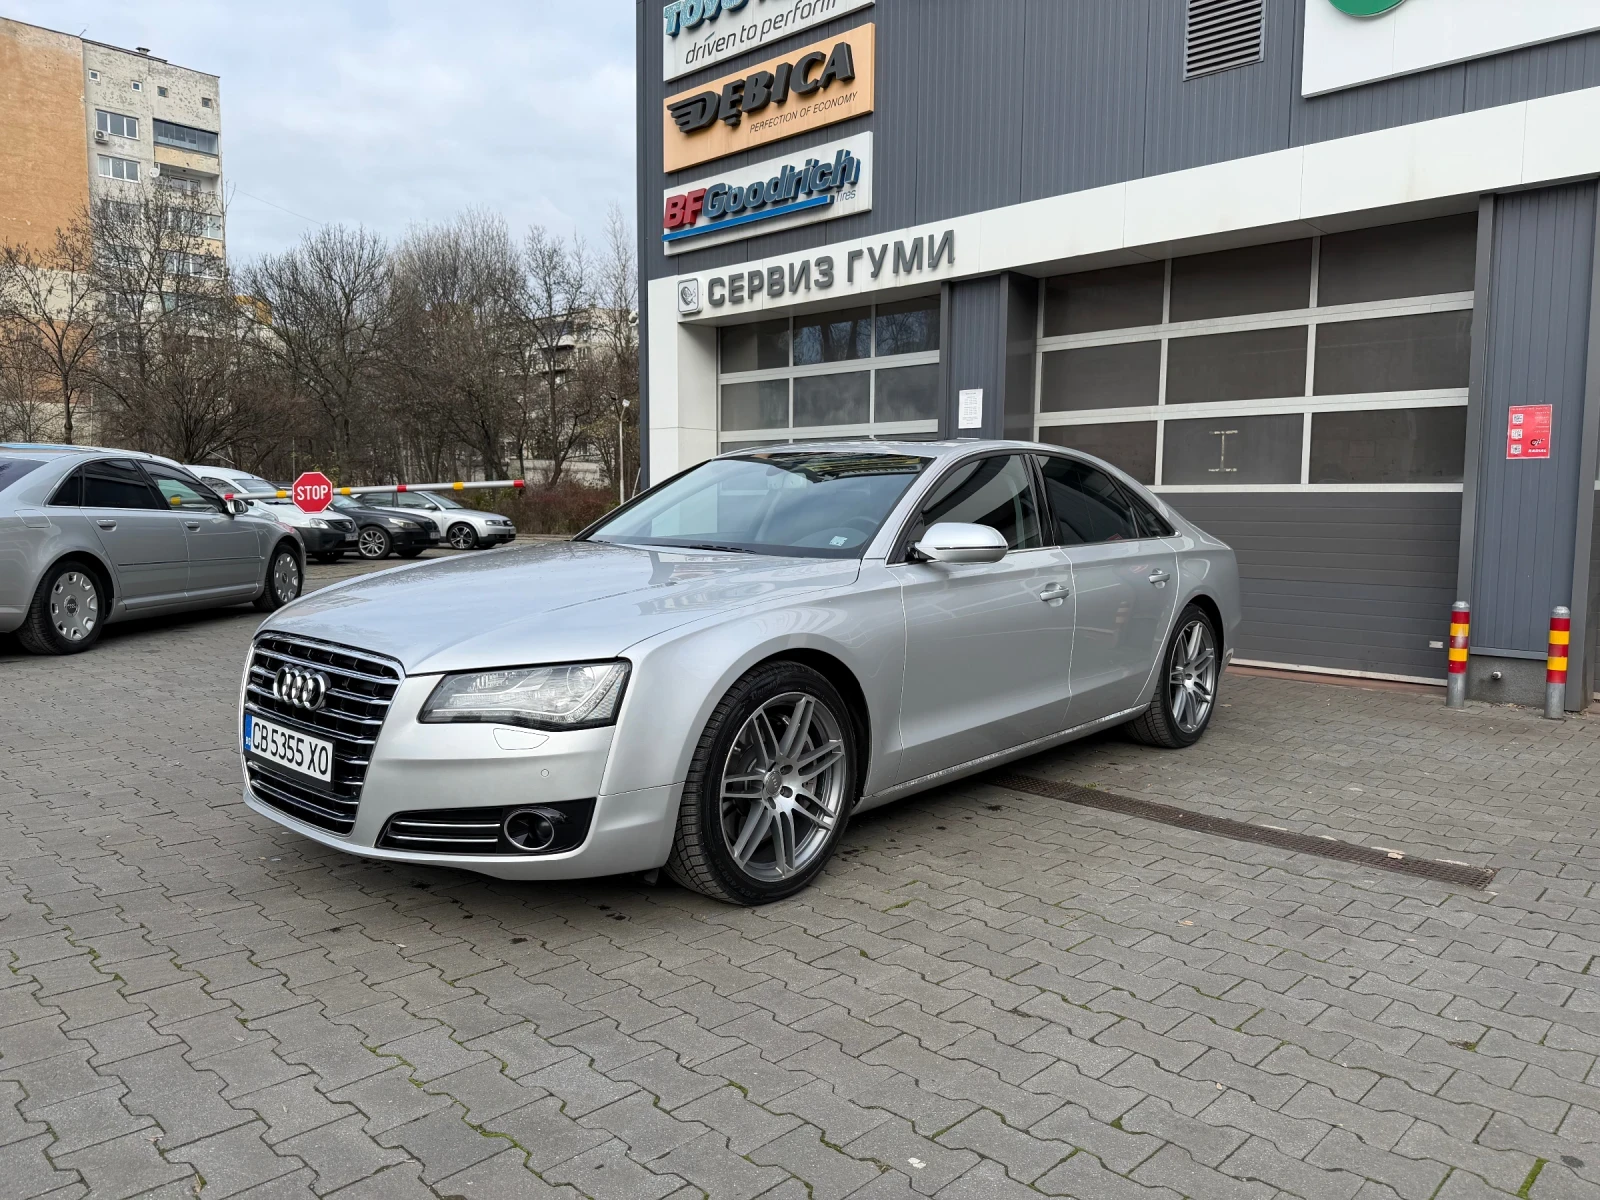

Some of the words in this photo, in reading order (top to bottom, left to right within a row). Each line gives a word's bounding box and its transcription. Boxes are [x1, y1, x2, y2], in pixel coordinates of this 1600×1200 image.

[739, 24, 758, 44] to
[759, 0, 836, 42] perform
[749, 110, 798, 134] PERFECTION
[799, 105, 812, 118] OF
[813, 91, 858, 114] ECONOMY
[663, 149, 862, 230] BFGoodrich
[835, 189, 857, 202] Tires
[707, 255, 834, 307] СЕРВИЗ
[847, 229, 956, 284] ГУМИ
[297, 484, 329, 501] STOP
[252, 721, 269, 753] CB
[270, 728, 305, 767] 5355
[307, 740, 329, 776] XO
